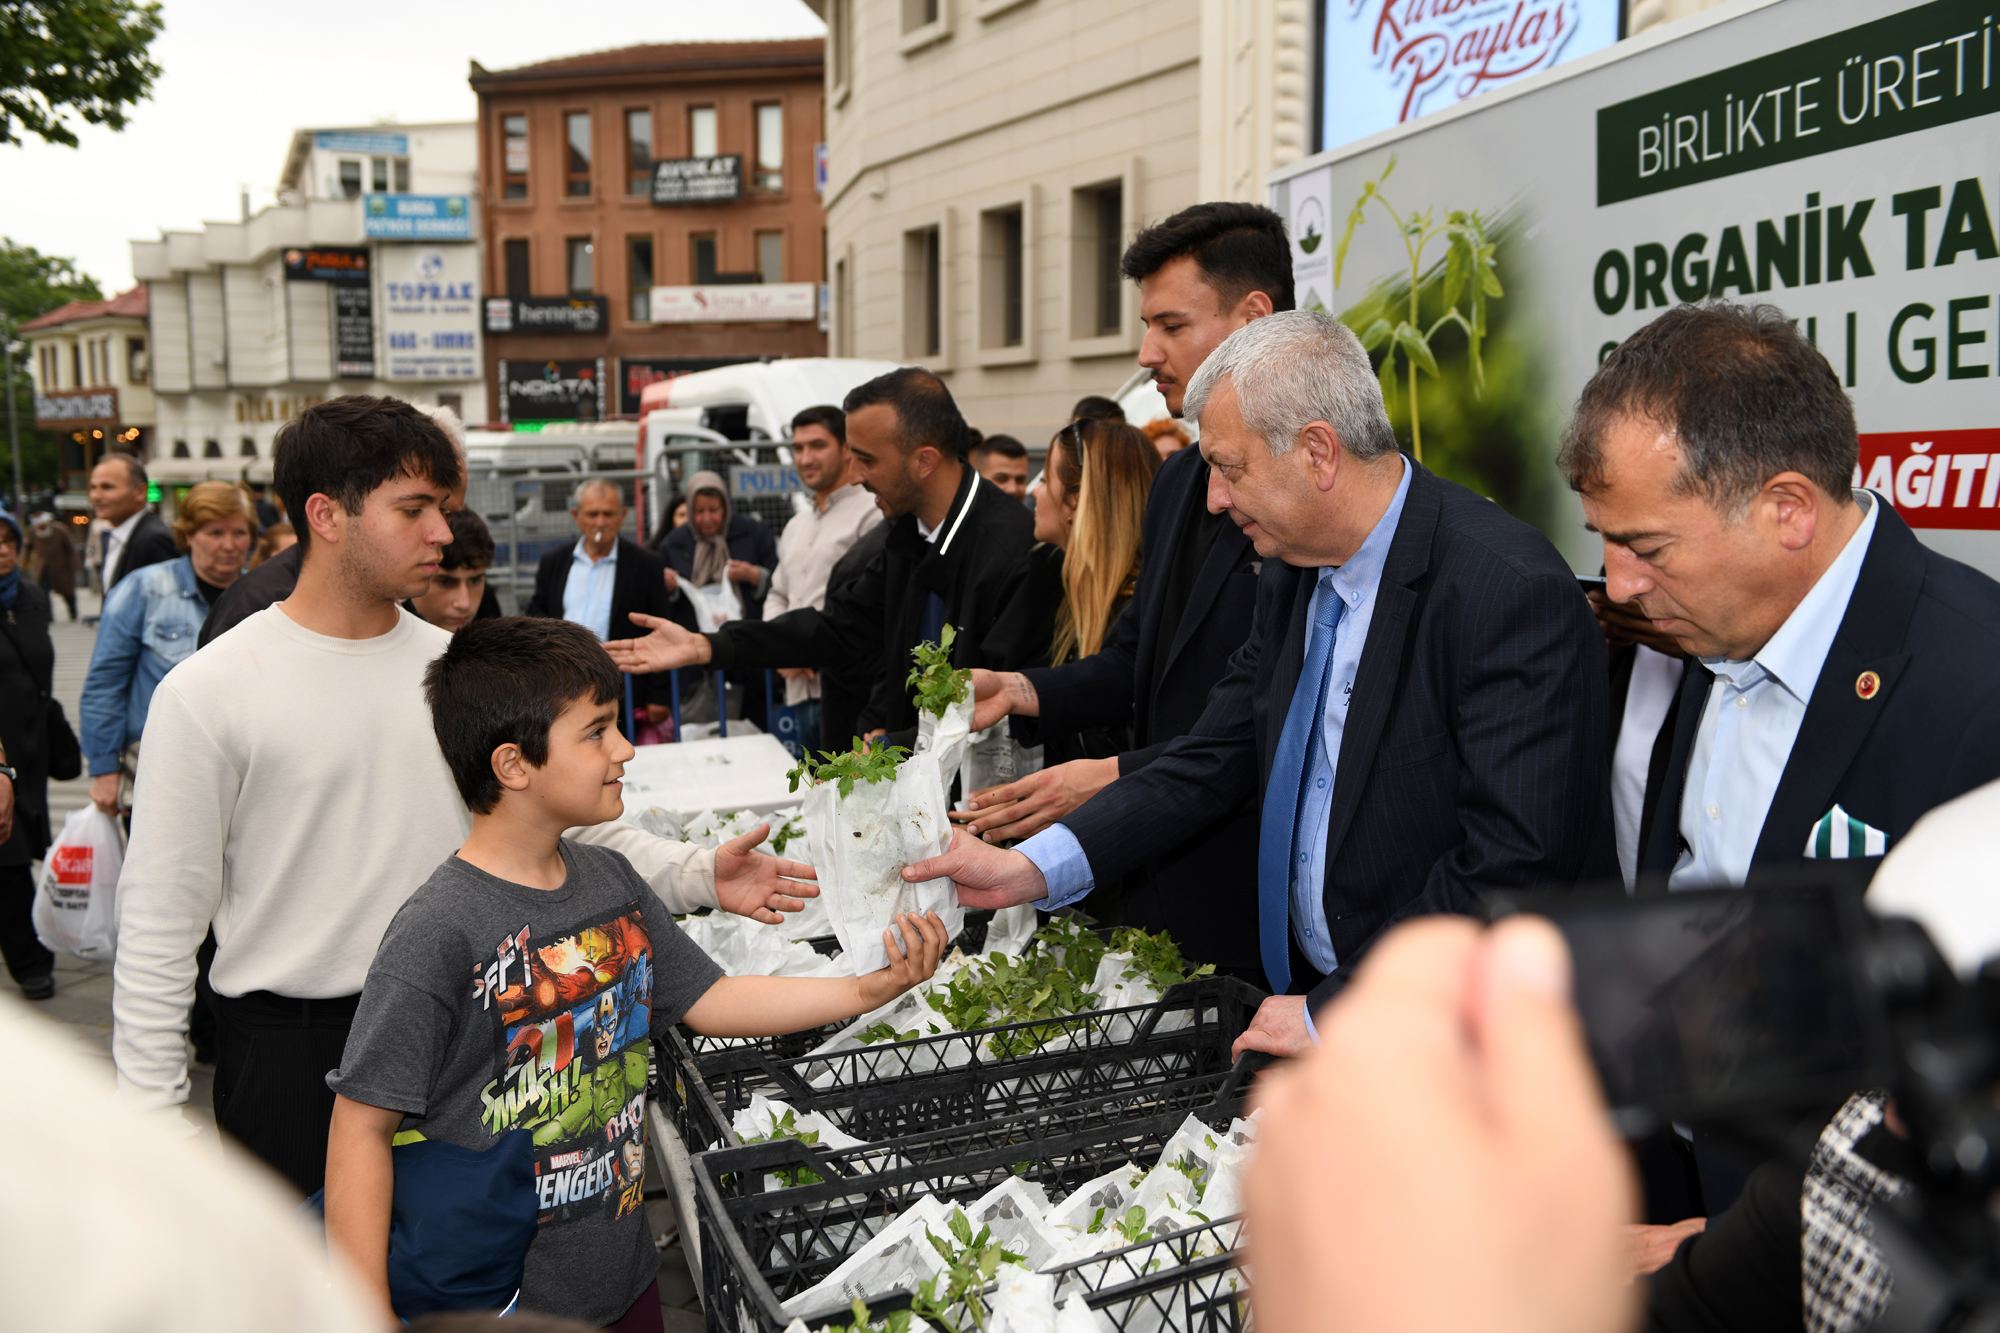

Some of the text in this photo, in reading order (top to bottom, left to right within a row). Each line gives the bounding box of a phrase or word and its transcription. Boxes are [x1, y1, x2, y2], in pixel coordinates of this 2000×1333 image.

[1638, 15, 2000, 179] BİRLİKTE ÜRETİ
[656, 156, 736, 179] AVUKAT
[1593, 177, 2000, 316] ORGANİK TA
[388, 283, 474, 300] TOPRAK
[519, 302, 599, 325] hennes
[1888, 294, 2000, 385] GE
[510, 378, 596, 397] NOKTA
[480, 1055, 583, 1136] SMASH!
[604, 1086, 648, 1142] THO
[550, 1151, 582, 1169] MARVEL
